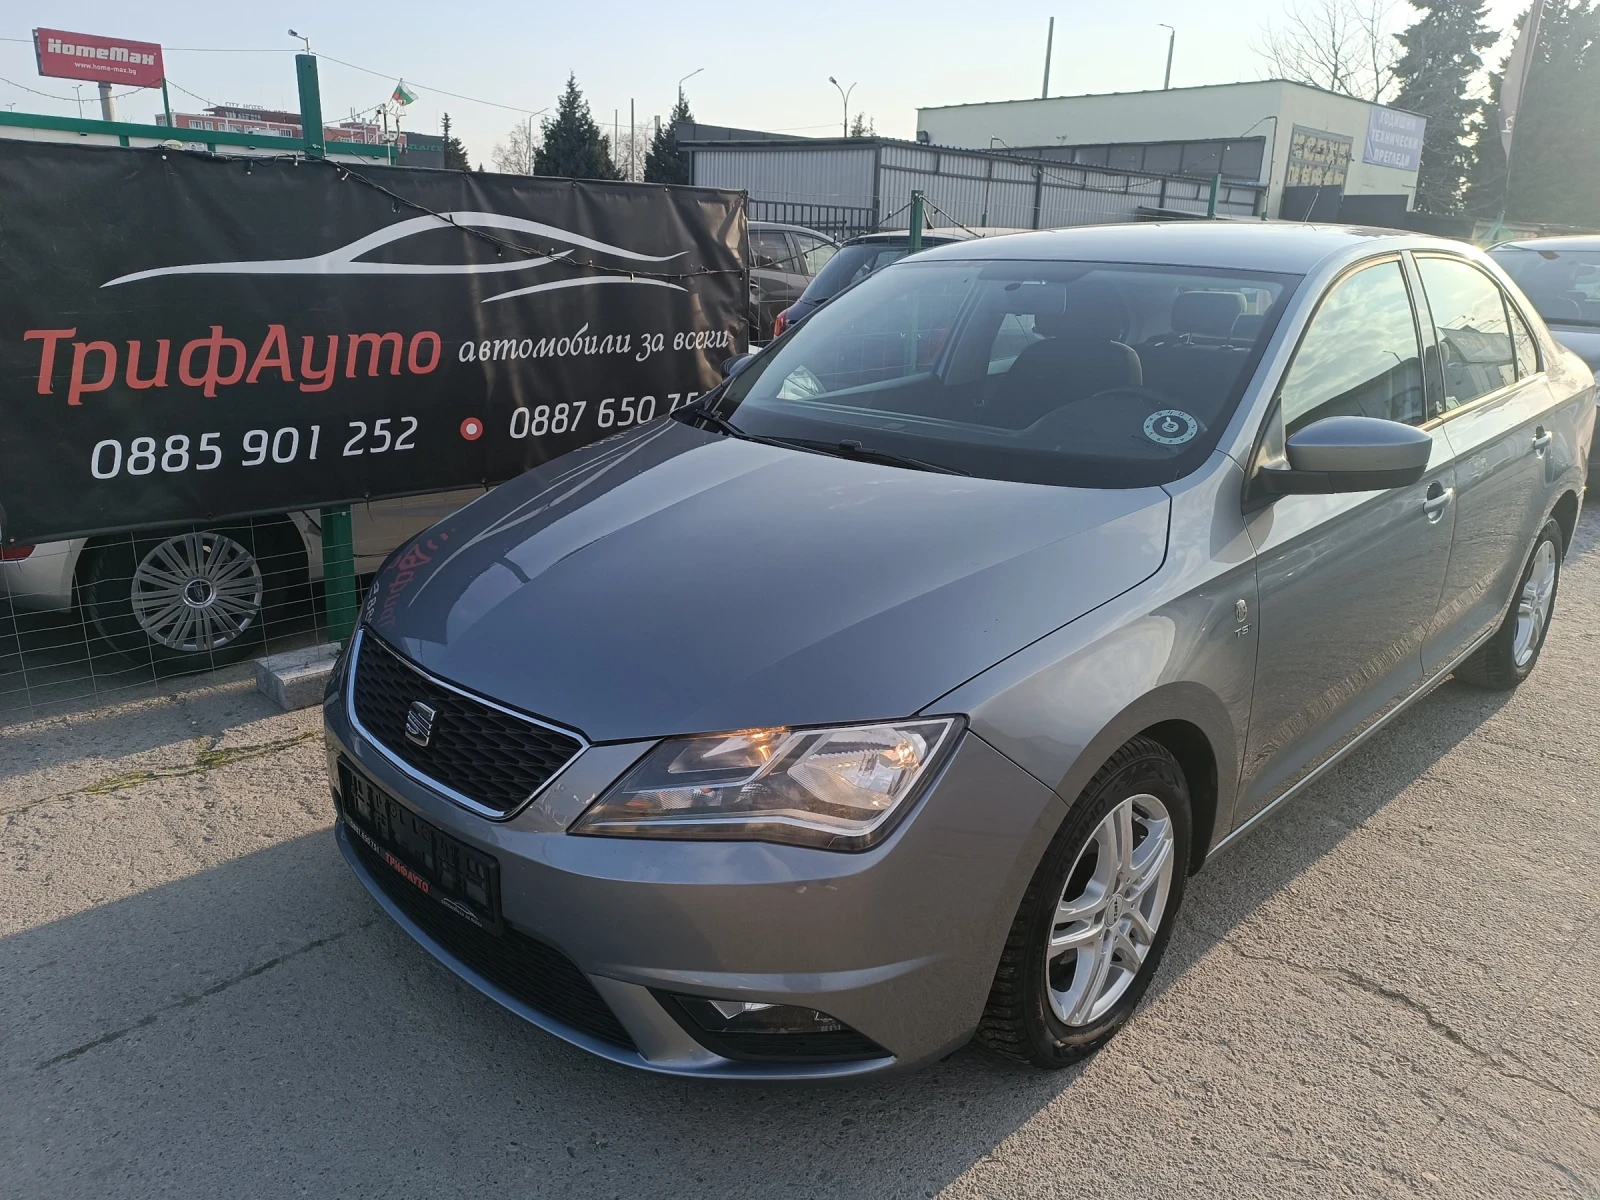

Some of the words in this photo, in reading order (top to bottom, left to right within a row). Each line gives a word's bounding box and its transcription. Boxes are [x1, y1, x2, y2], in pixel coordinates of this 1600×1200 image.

[47, 38, 155, 66] HomeMax
[74, 62, 137, 76] www.home-max.bg
[1379, 111, 1417, 131] ГОДИШНИ
[1371, 128, 1419, 150] ТЕХНИЧЕСКИ
[1372, 148, 1411, 168] ПРЕГЛЕДИ
[459, 323, 631, 362] автомобили
[636, 333, 665, 362] за
[674, 329, 729, 350] всеки
[509, 401, 587, 439] 0887
[598, 395, 656, 428] 650
[91, 432, 222, 480] 0885
[242, 426, 320, 466] 901
[343, 416, 418, 457] 252
[385, 852, 430, 893] ТРИФАУТО
